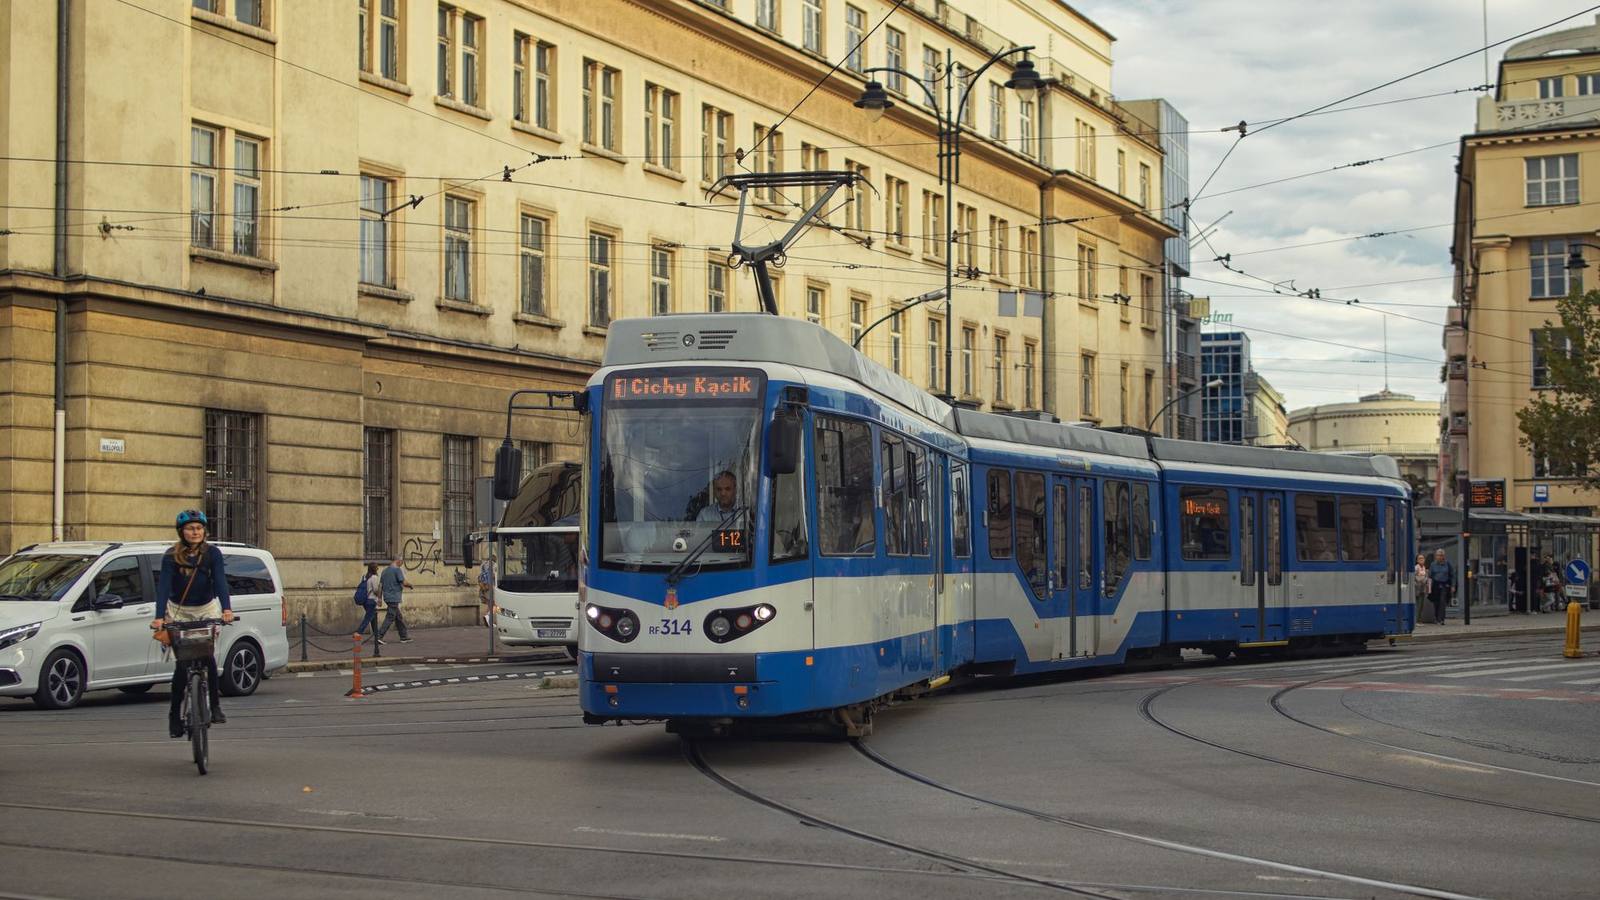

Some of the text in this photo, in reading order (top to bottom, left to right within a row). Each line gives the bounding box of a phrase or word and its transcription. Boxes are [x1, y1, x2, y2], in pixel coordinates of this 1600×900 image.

[631, 377, 687, 396] Cichy
[694, 376, 752, 396] Kącik
[720, 531, 741, 546] 1-12
